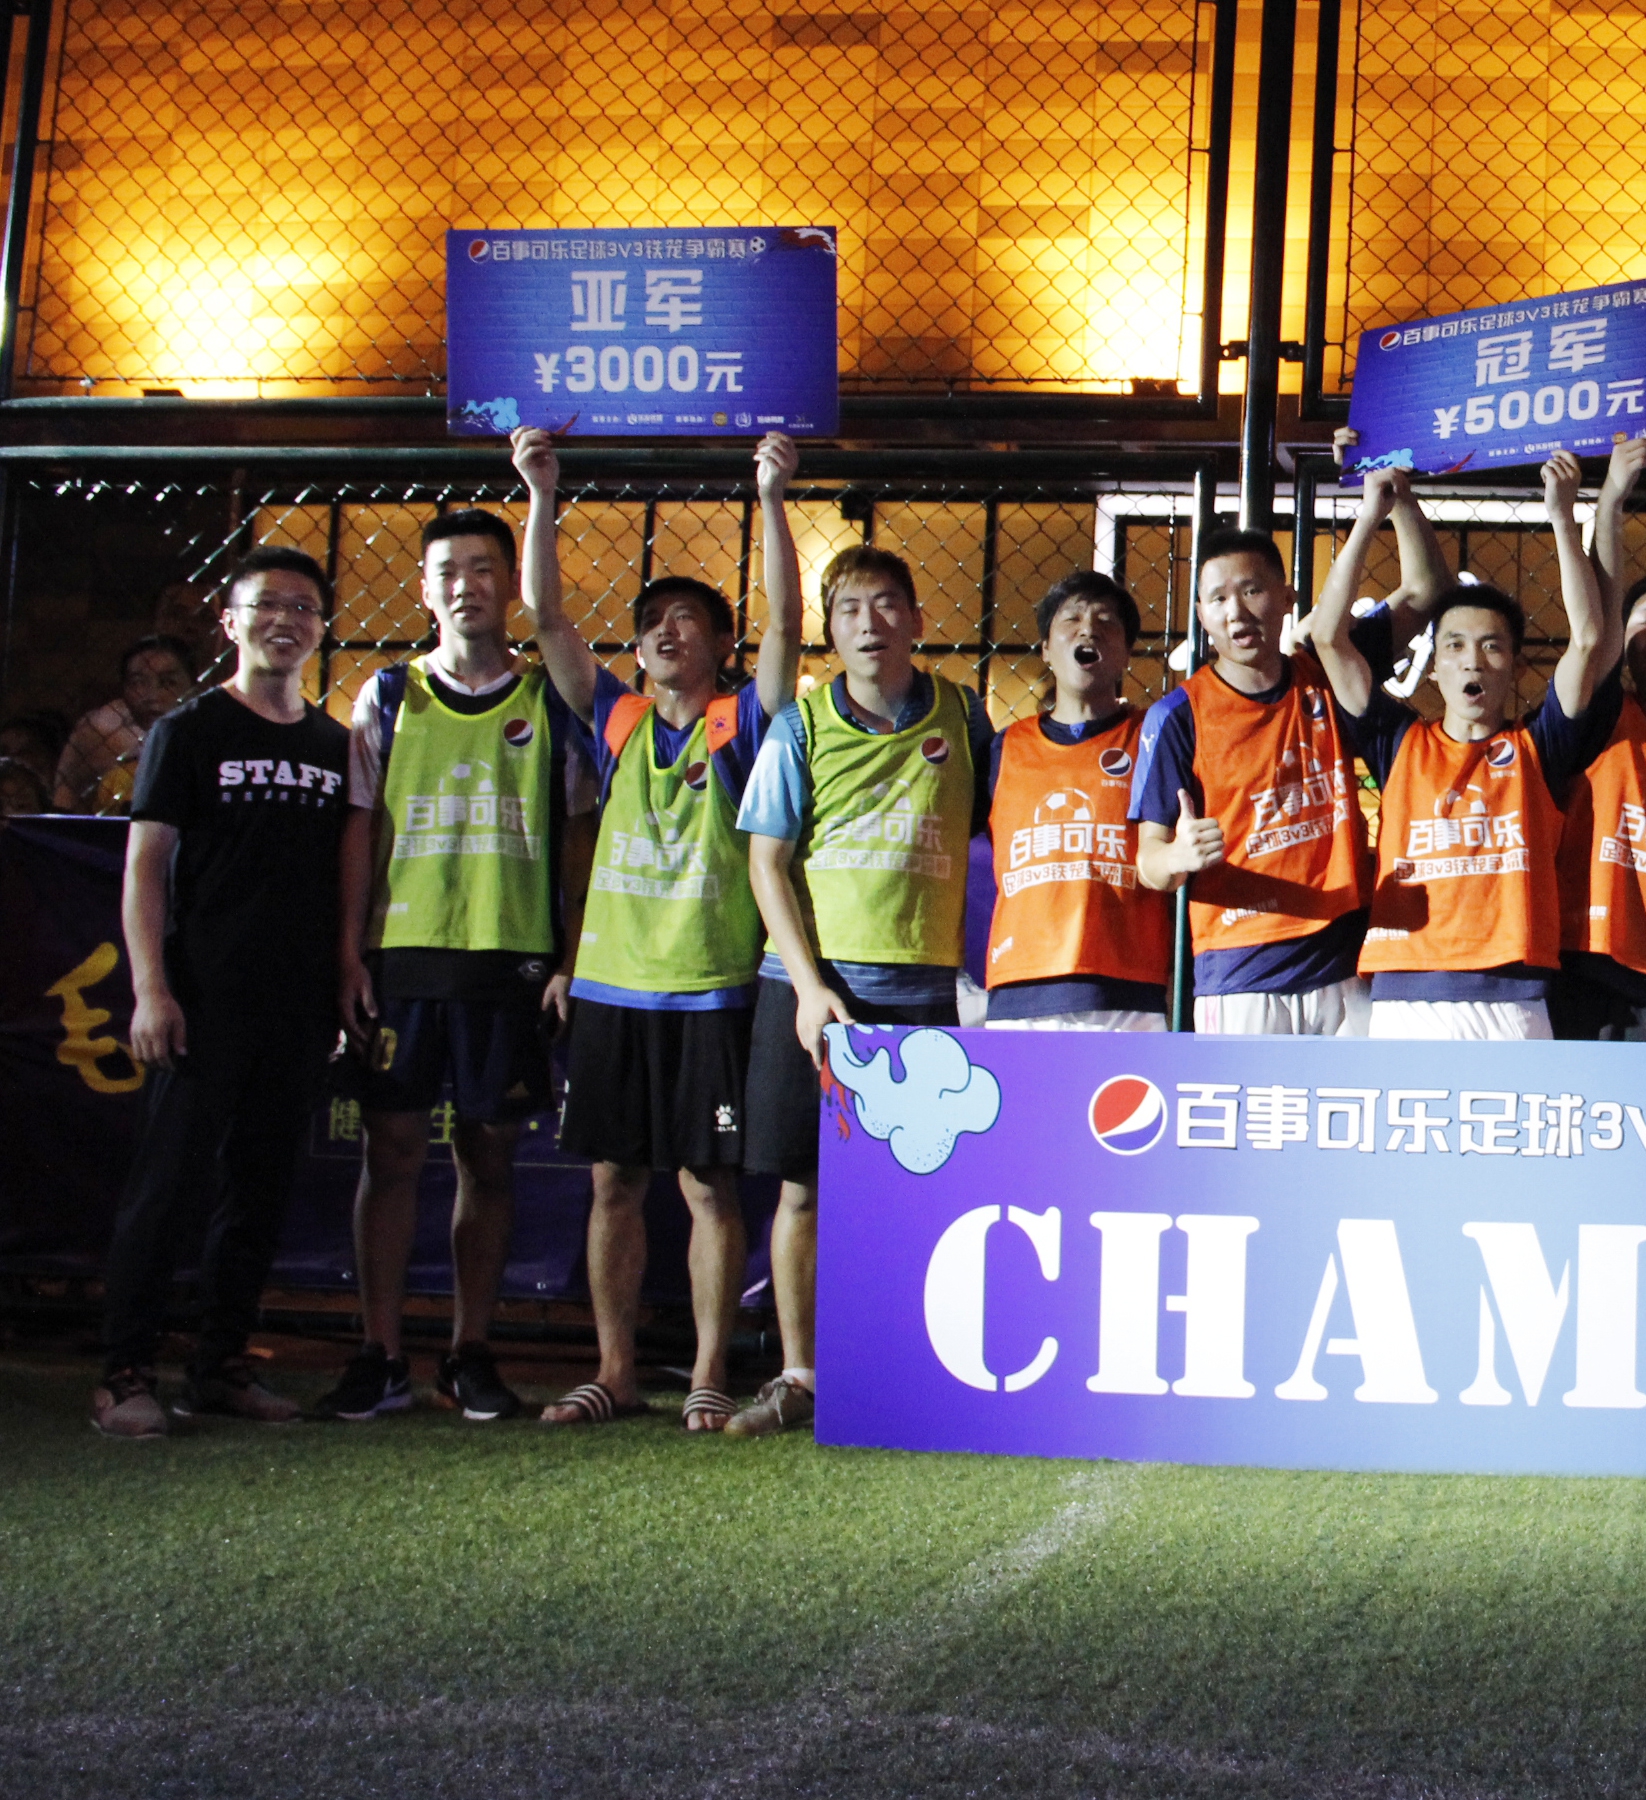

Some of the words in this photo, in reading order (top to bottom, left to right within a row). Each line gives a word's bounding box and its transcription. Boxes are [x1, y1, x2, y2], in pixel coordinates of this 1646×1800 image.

[492, 238, 746, 261] 百事可乐足球3V3铁笼争霸赛
[570, 269, 704, 333] 亚军
[533, 345, 744, 394] ¥3000元
[1475, 317, 1607, 388] 冠军
[1432, 377, 1645, 440] ¥5000元
[219, 759, 342, 795] STAFF
[405, 794, 530, 833] 百事可乐
[1405, 810, 1526, 858] 百事可乐
[1010, 823, 1127, 869] 百事可乐
